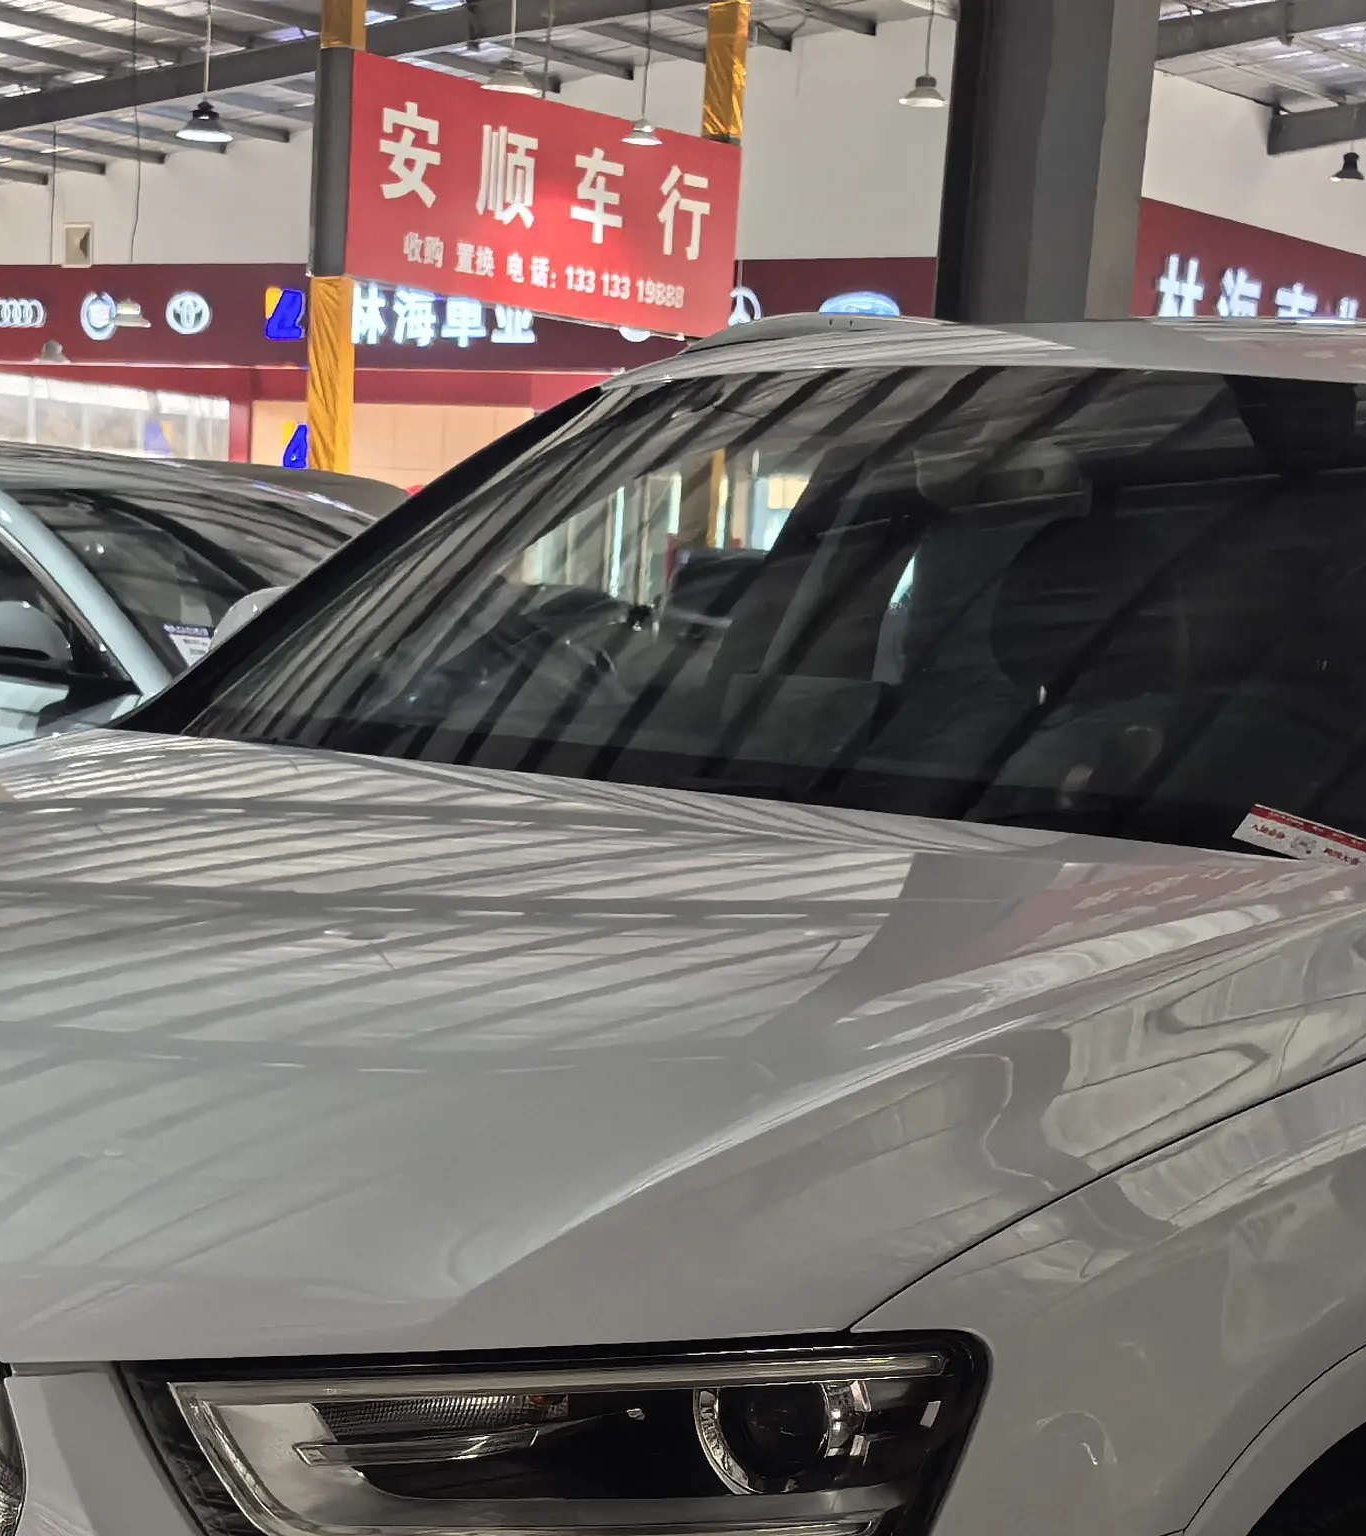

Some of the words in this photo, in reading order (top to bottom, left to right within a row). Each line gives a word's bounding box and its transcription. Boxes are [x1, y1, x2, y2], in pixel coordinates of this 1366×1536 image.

[378, 101, 711, 261] 安顺车行
[403, 231, 445, 268] 收购
[454, 240, 496, 278] 置换
[565, 265, 596, 294] 133
[601, 271, 631, 300] 133
